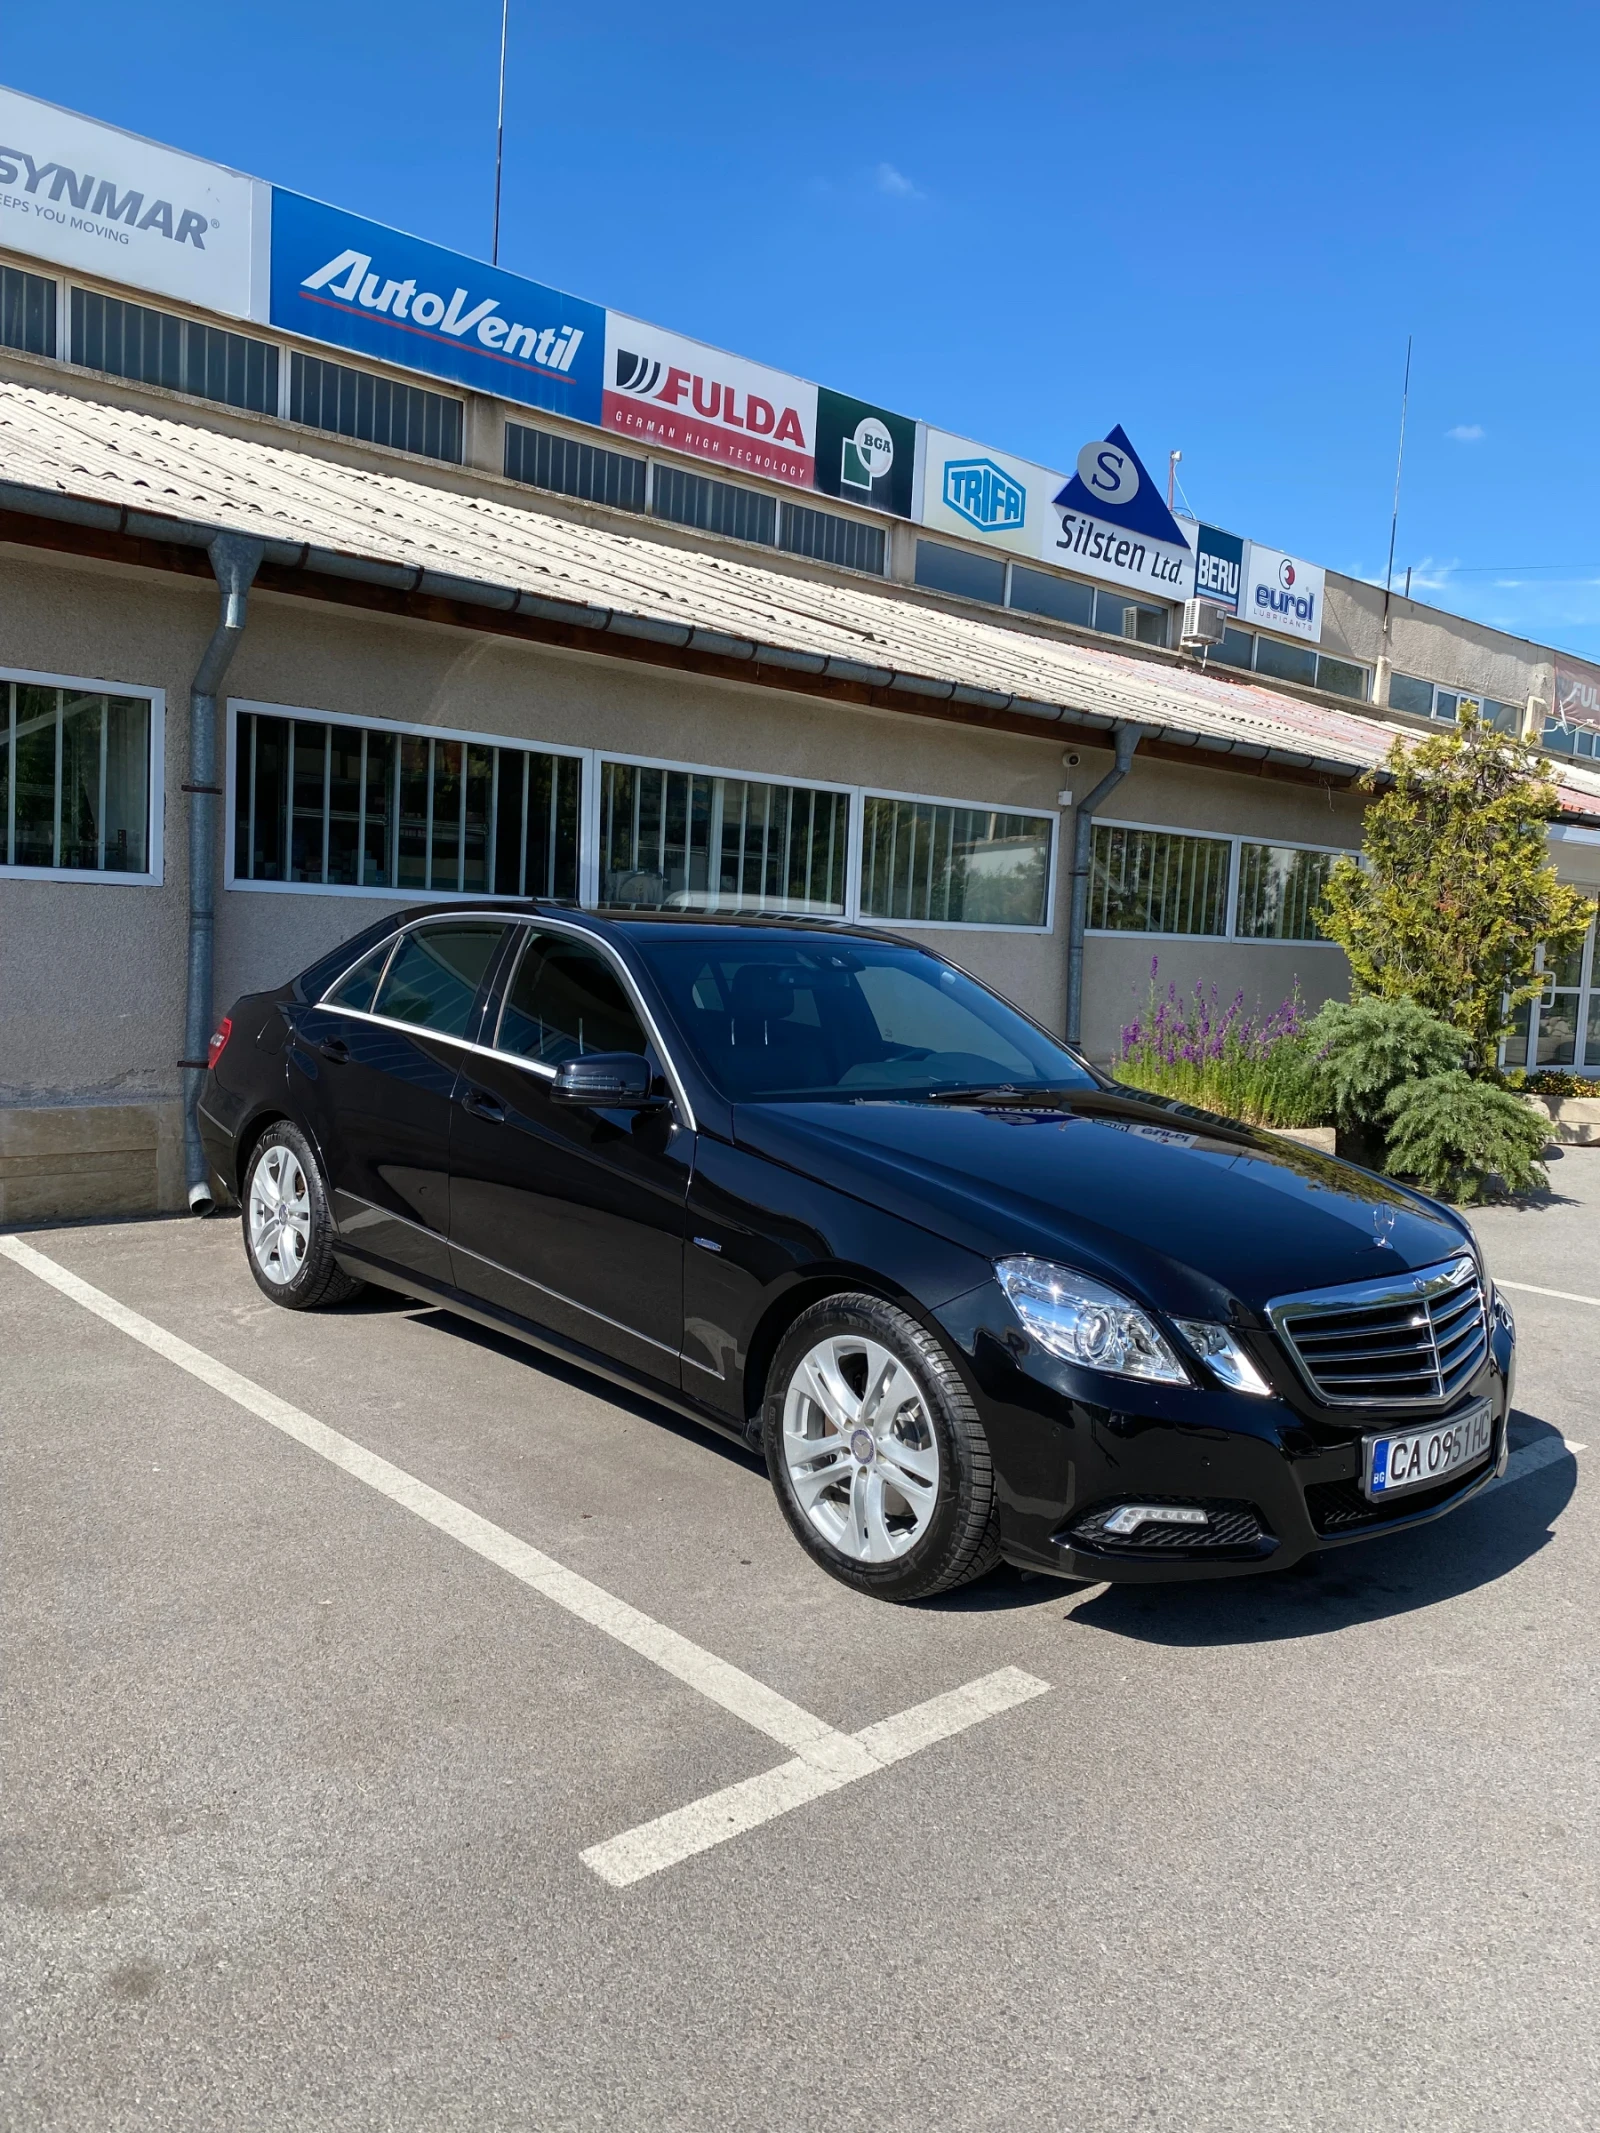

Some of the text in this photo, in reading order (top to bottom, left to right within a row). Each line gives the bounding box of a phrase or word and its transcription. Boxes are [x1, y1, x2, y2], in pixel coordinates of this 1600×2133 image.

[35, 204, 66, 224] YOU
[70, 217, 130, 245] MOVING
[300, 249, 585, 372] AutoVentil
[654, 366, 806, 449] FULDA
[615, 410, 806, 479] GERMAN HIGH TECNOLOGY
[863, 433, 891, 454] BGA
[1091, 451, 1124, 492] S
[951, 468, 1020, 523] TRIFA
[1056, 514, 1184, 586] Silsten Ltd.
[1197, 551, 1240, 595] BERU
[1253, 607, 1313, 632] LUBRICANTS
[1255, 584, 1315, 623] eurol
[1390, 1409, 1490, 1481] CA 0951 HC
[1373, 1471, 1385, 1485] BG
